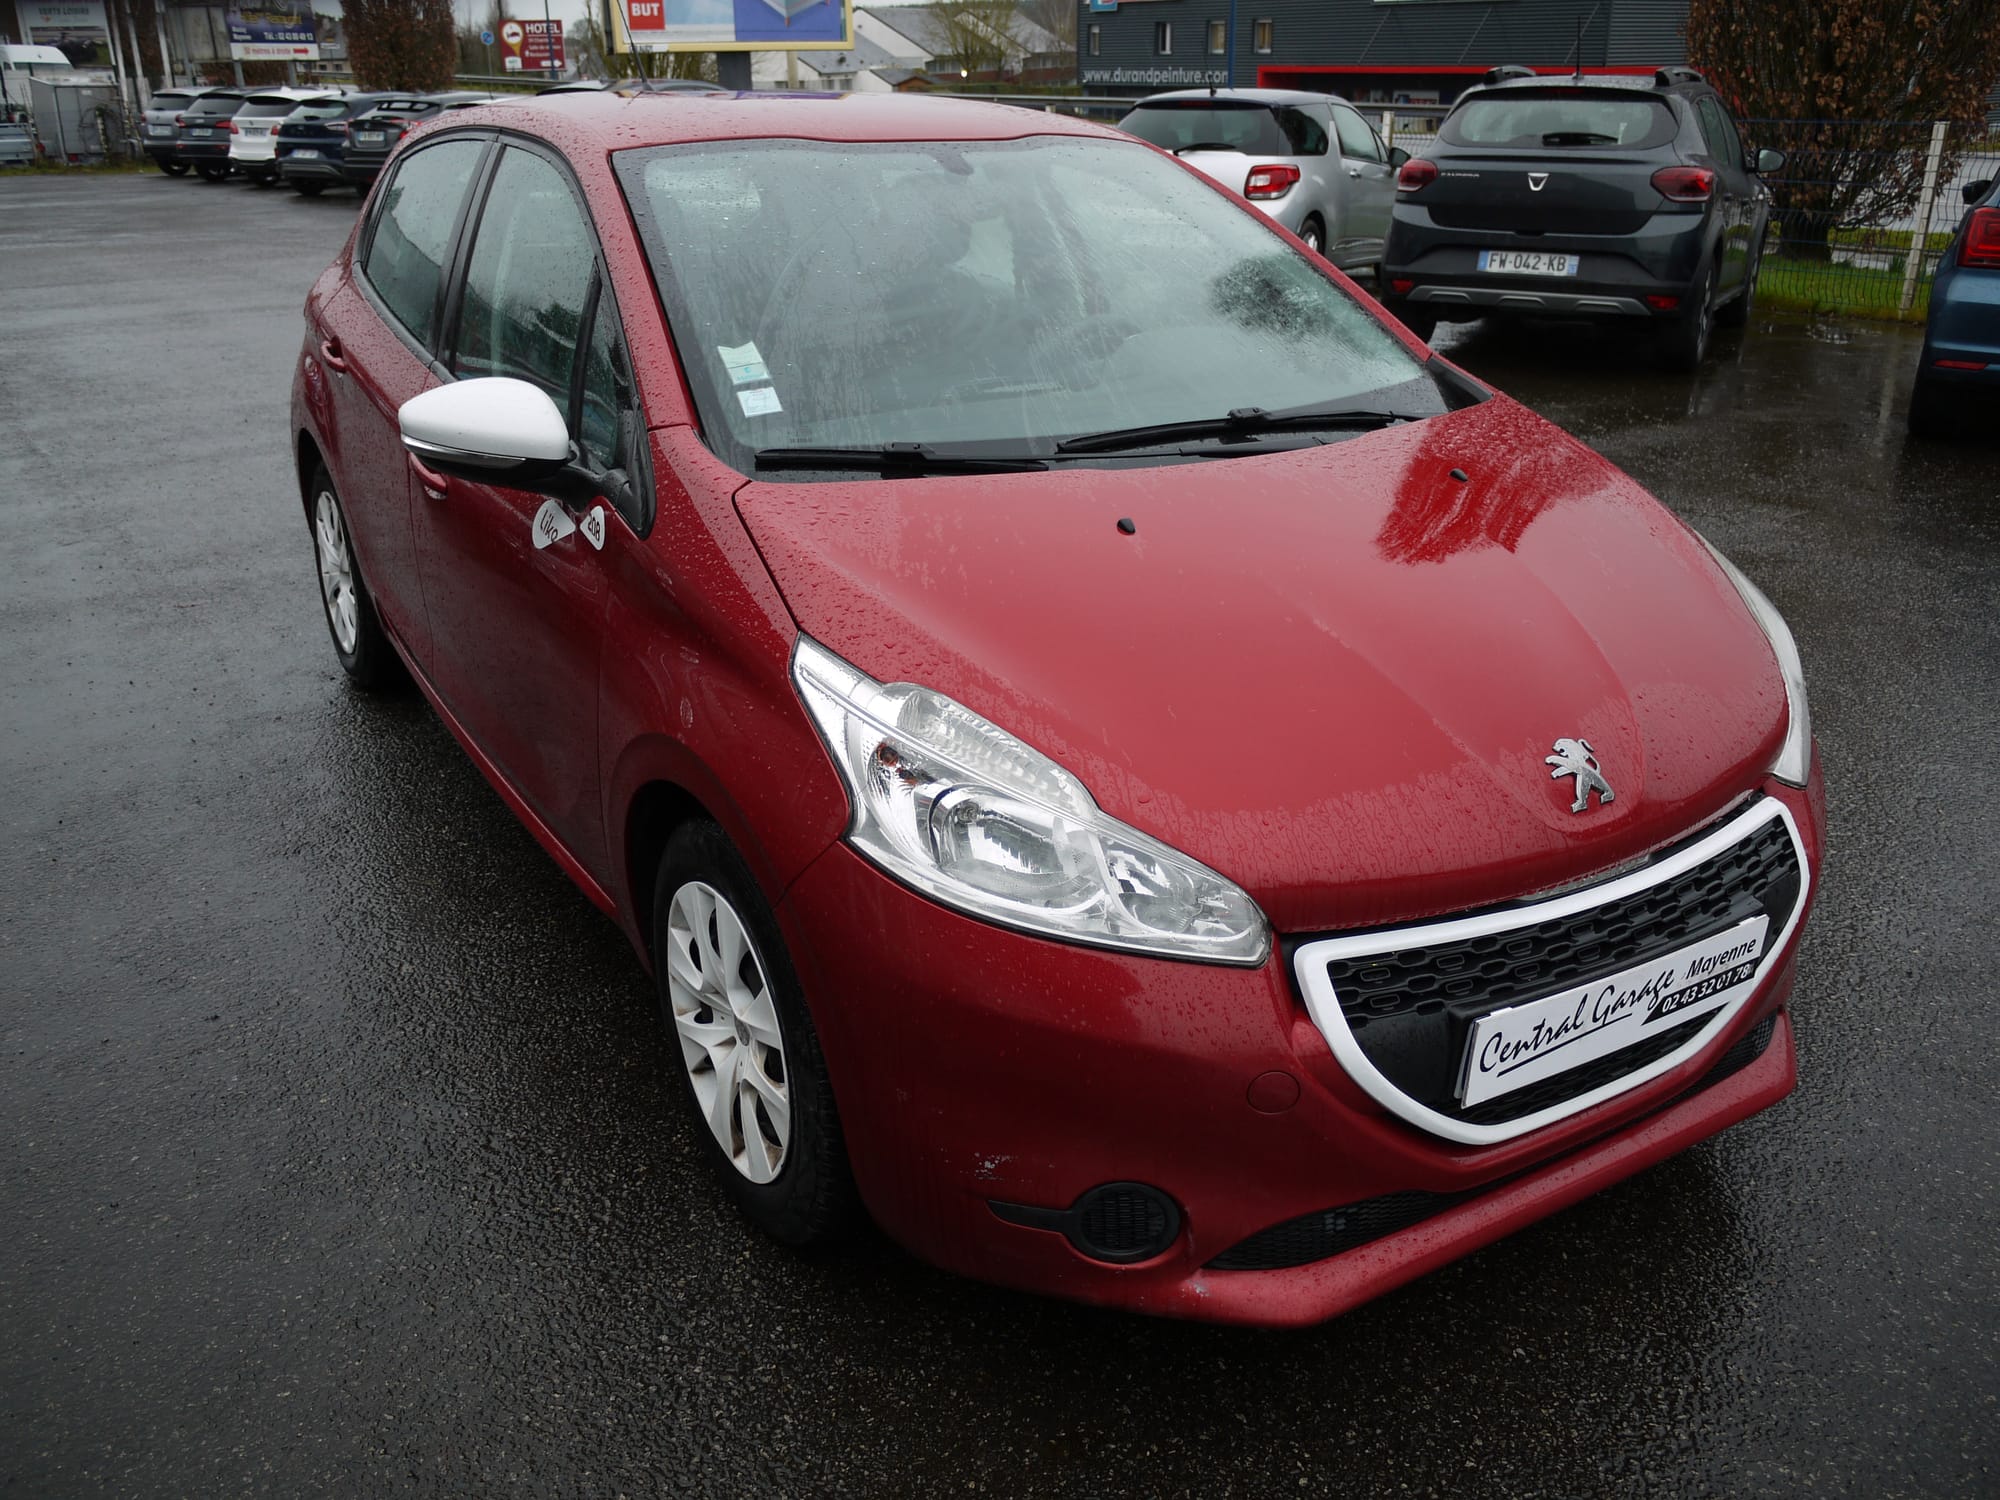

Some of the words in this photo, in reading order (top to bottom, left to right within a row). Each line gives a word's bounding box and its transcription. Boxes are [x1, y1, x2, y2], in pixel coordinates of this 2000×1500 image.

[631, 3, 660, 16] BUT
[525, 23, 560, 33] HOTEL
[1489, 253, 1567, 272] FW-042-KB
[1686, 939, 1757, 979] Mayenne
[1662, 996, 1678, 1013] 02
[1680, 987, 1697, 1005] 43
[1698, 979, 1716, 998] 32
[1716, 971, 1732, 990] 01
[1733, 964, 1750, 983] 78
[1480, 993, 1588, 1073] Central
[1592, 969, 1675, 1025] Garage
